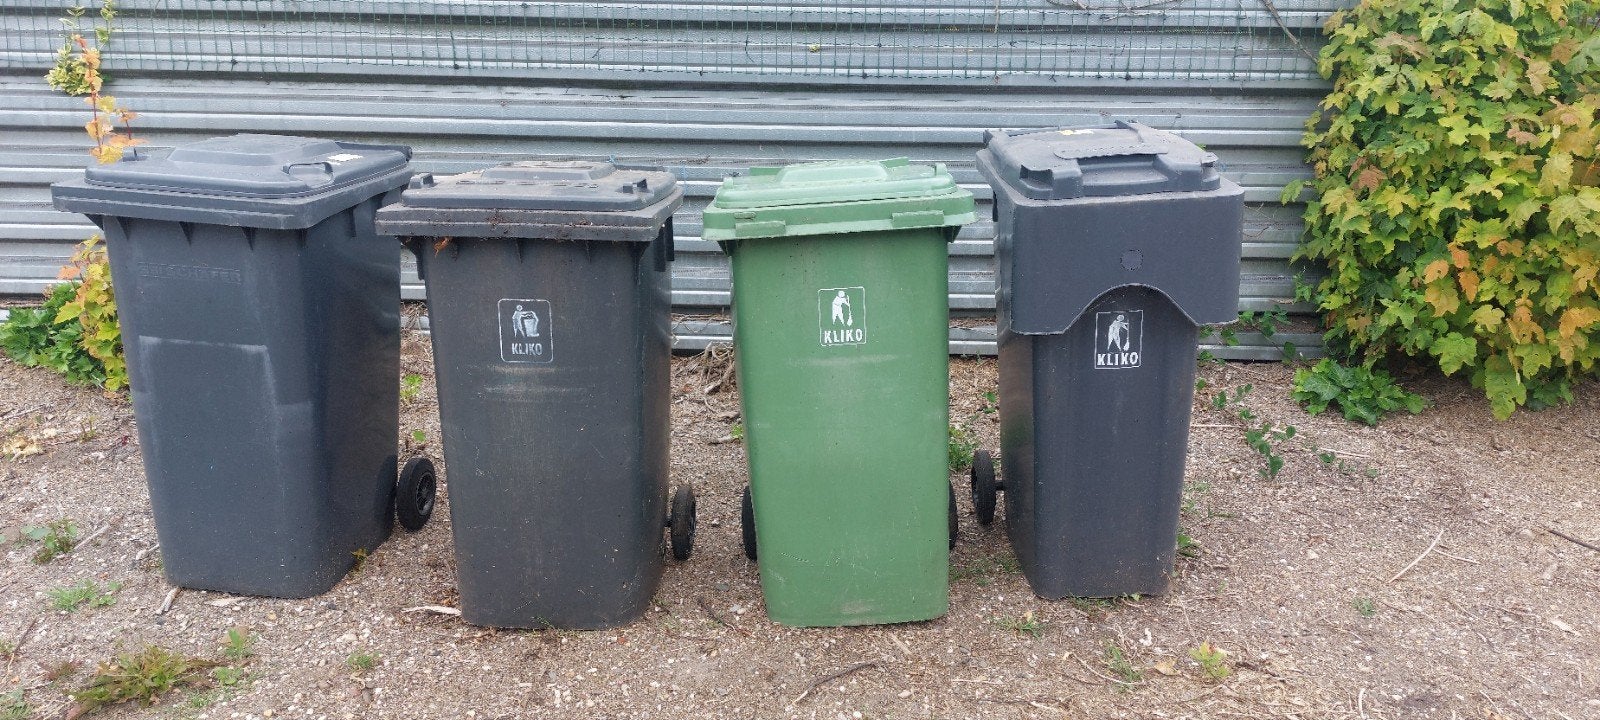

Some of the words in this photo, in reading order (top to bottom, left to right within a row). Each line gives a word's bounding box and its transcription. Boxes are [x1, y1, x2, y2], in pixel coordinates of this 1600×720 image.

[824, 328, 863, 344] KLIKO
[511, 342, 543, 356] KLIKO
[1096, 351, 1139, 366] KLIKO
